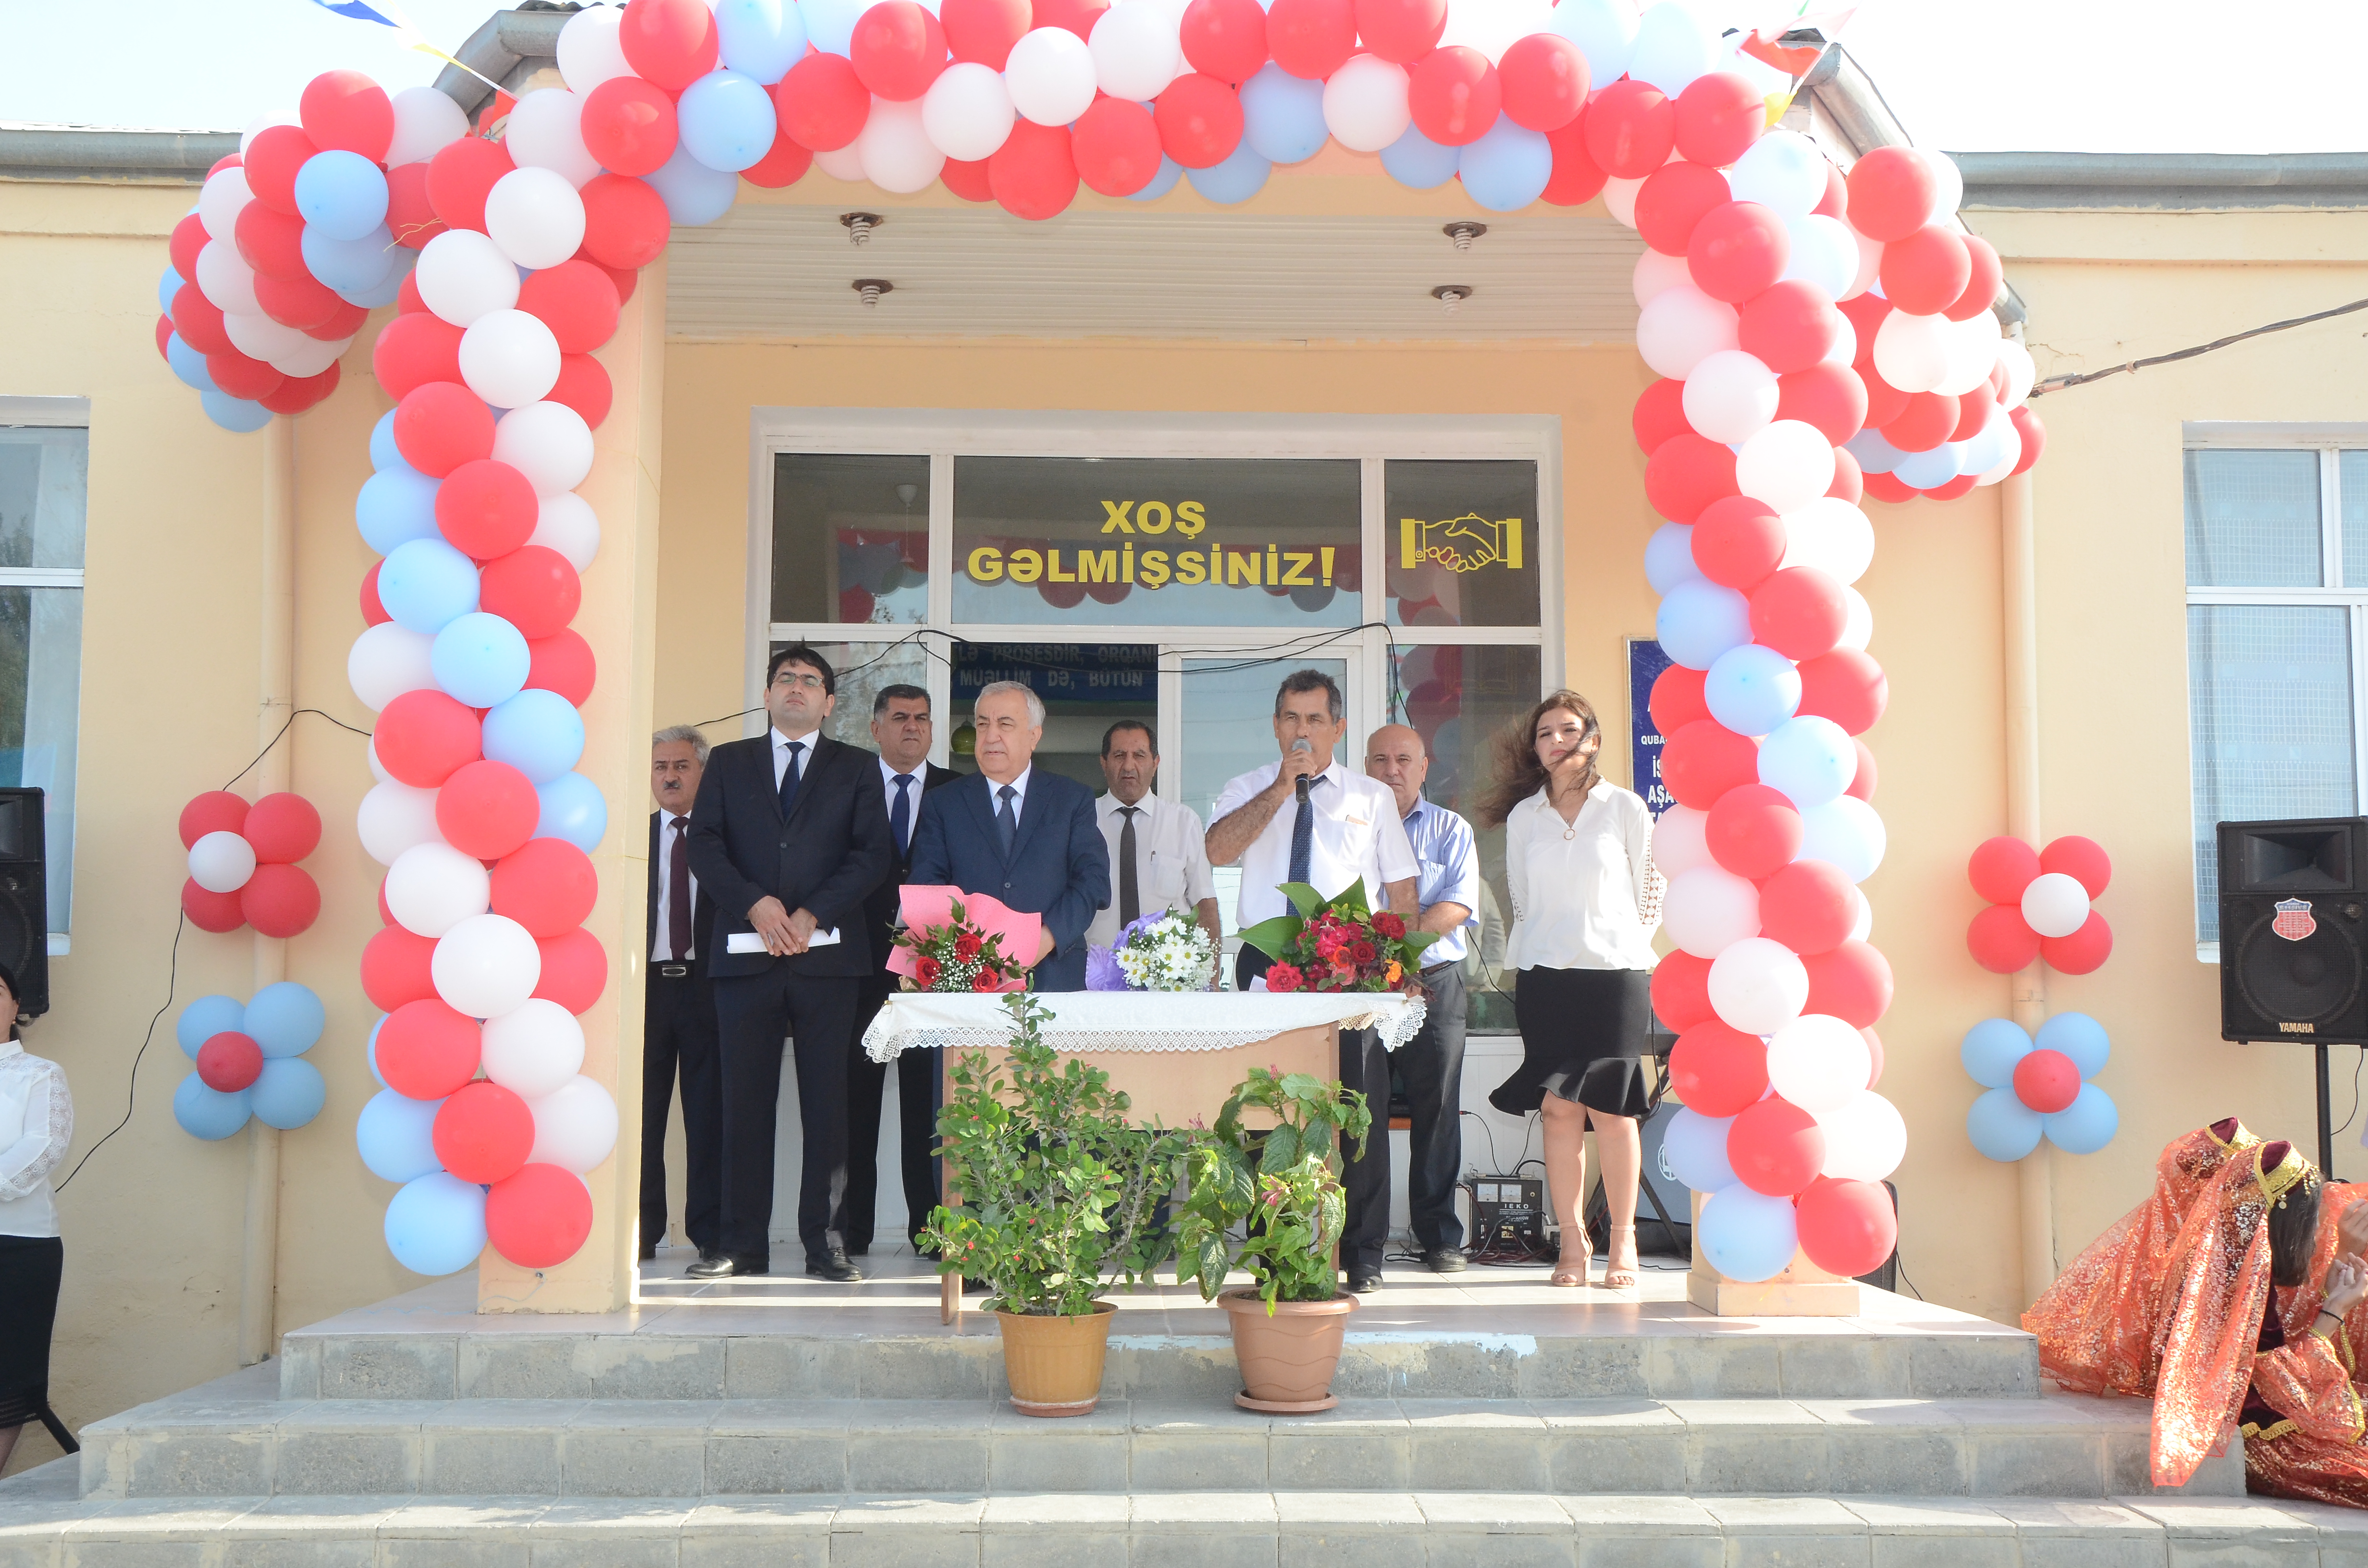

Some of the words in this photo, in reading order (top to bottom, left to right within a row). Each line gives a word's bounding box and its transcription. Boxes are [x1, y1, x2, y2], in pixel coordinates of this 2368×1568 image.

[1101, 501, 1206, 539] XOŞ
[968, 542, 1336, 588] GƏLMİŞSİNİZ!
[1048, 670, 1075, 690] DƏ,
[1089, 667, 1143, 686] BÜTÜN
[2279, 1022, 2314, 1033] YAMAHA
